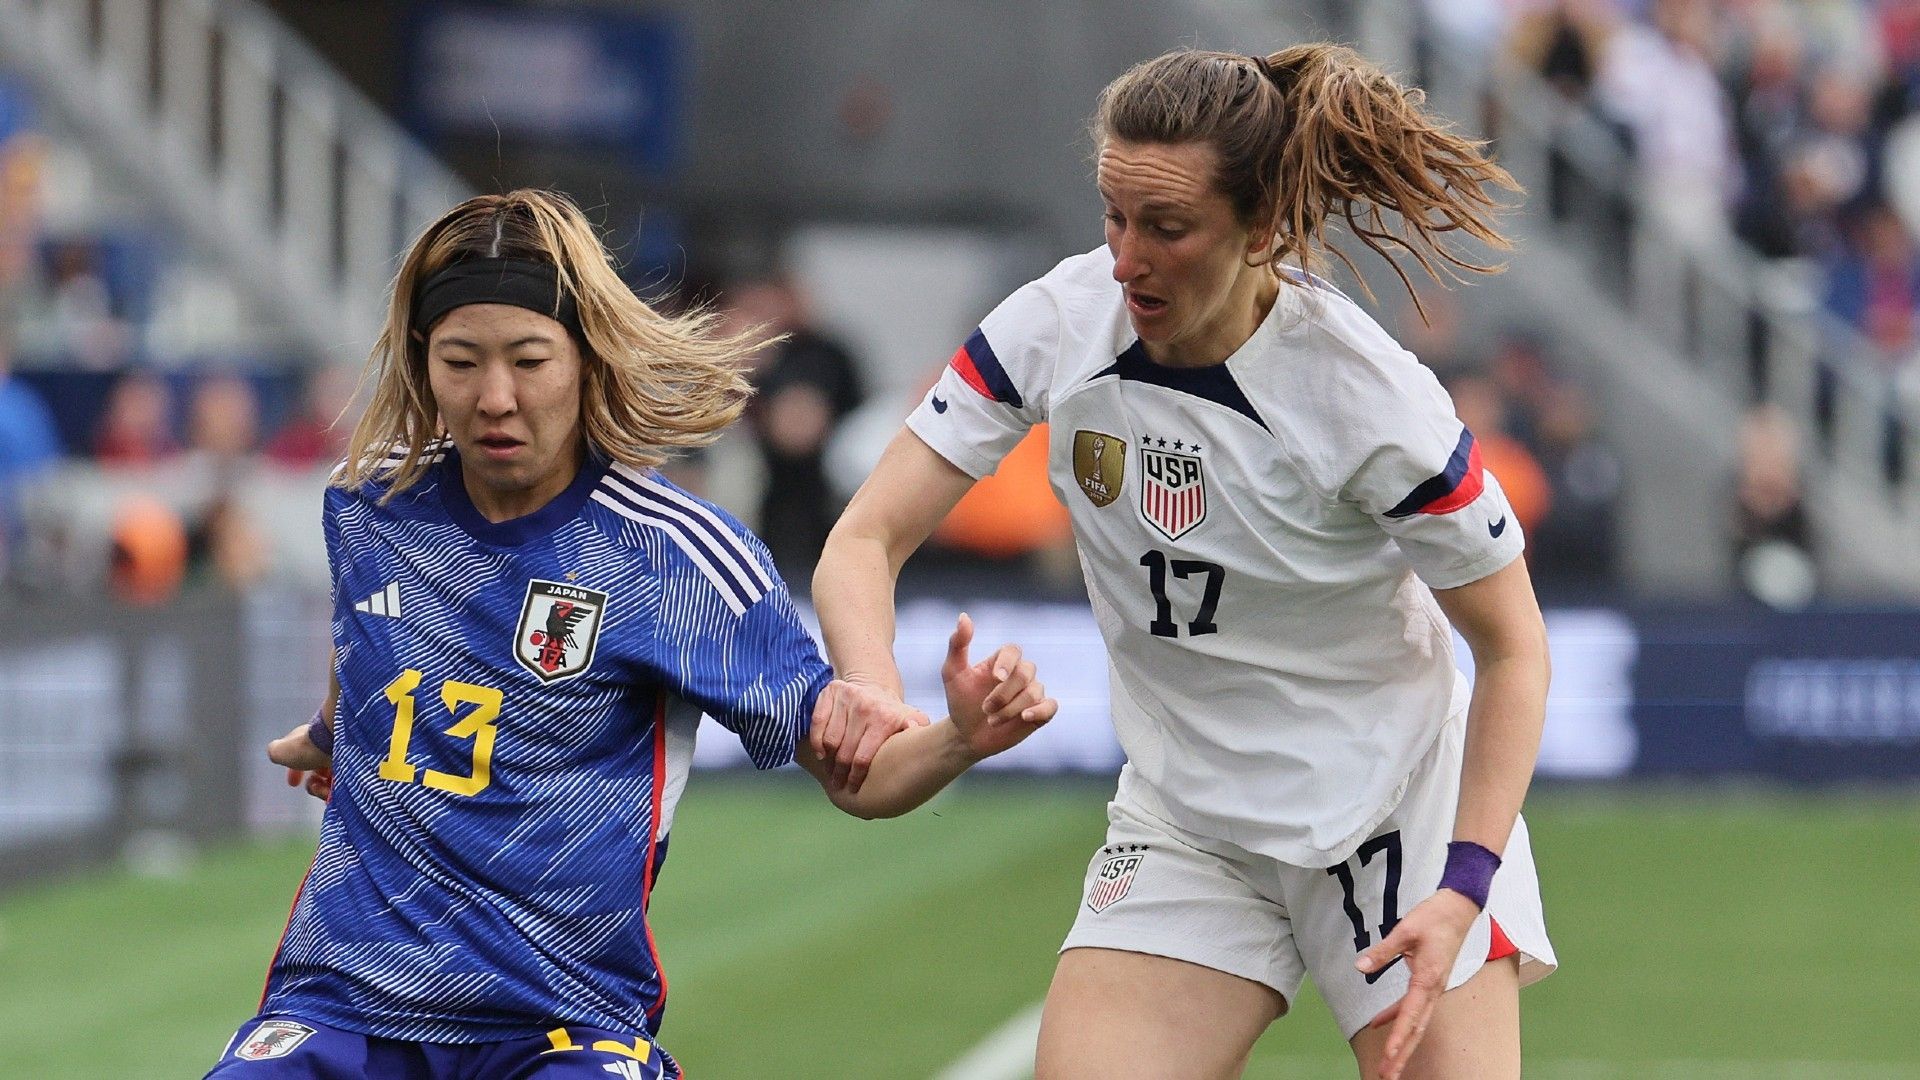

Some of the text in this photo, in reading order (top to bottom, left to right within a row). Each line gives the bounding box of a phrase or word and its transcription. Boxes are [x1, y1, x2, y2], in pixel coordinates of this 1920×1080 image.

[1147, 454, 1199, 488] USA
[1085, 477, 1107, 494] FIFA
[547, 585, 587, 600] JAPAN
[1140, 549, 1225, 638] 17
[533, 648, 567, 668] JFA
[378, 668, 504, 797] 13
[1100, 858, 1139, 880] USA
[1326, 829, 1403, 953] 17
